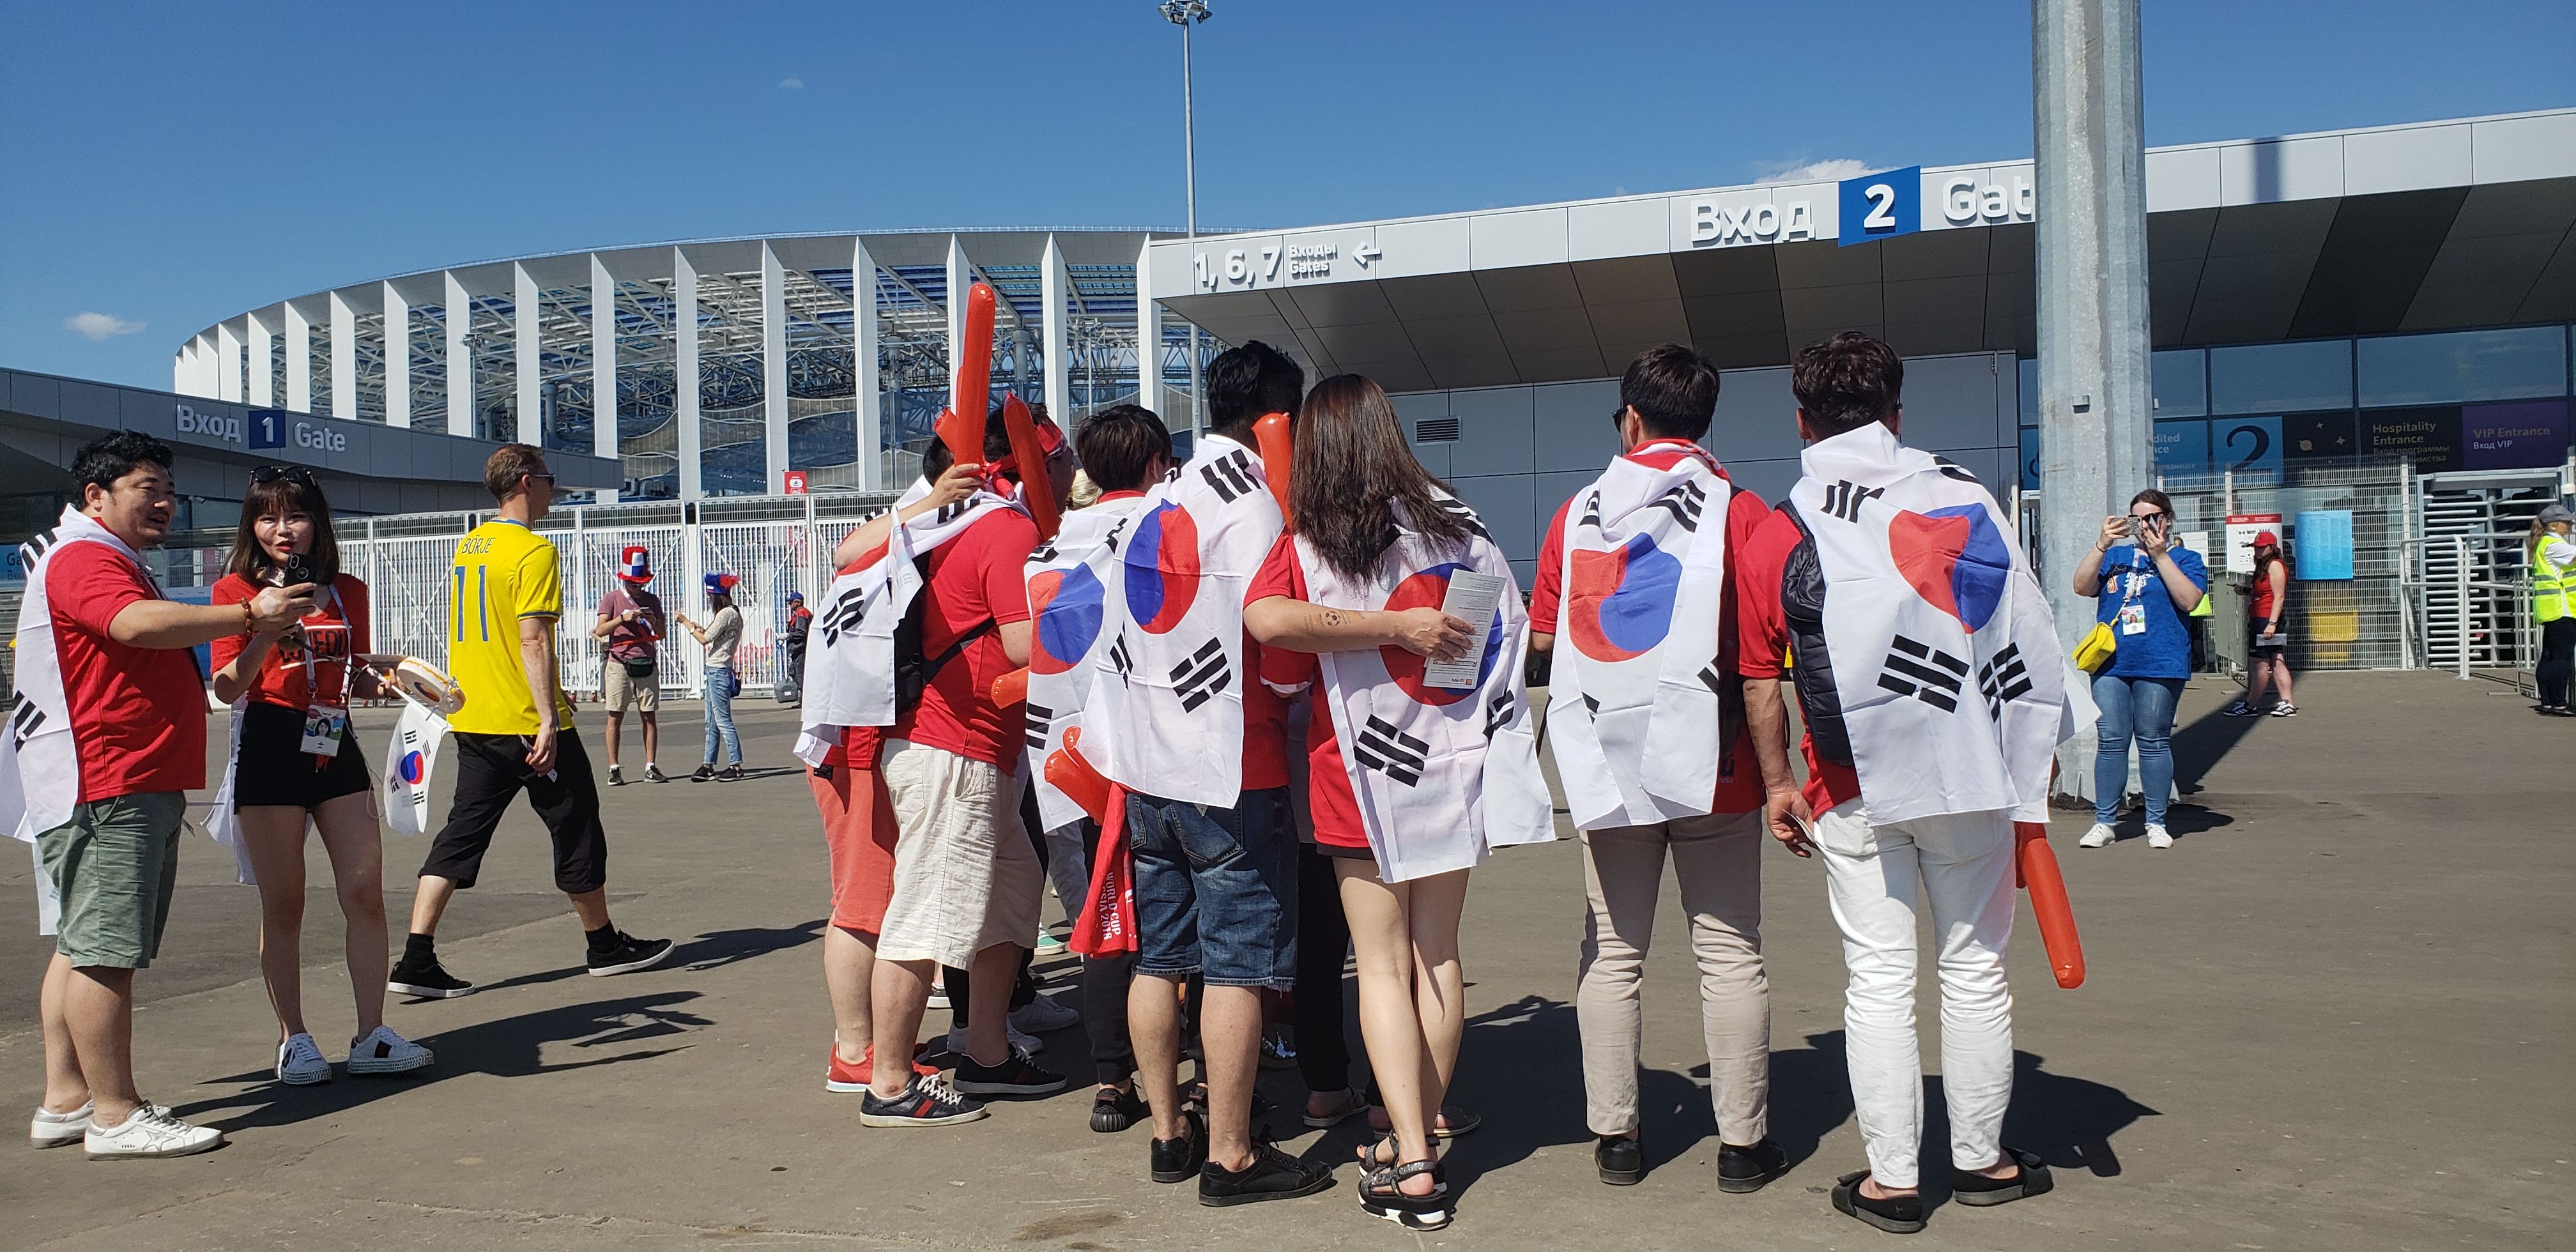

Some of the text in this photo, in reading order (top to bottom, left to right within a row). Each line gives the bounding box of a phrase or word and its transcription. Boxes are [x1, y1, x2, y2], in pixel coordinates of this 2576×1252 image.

[1690, 176, 2032, 241] Вход 2 Gat
[1288, 243, 1337, 258] Входы
[1194, 246, 1282, 287] 1, 6, 7
[1289, 260, 1329, 275] Gates
[177, 404, 346, 452] Вход 1 Gate
[2372, 421, 2436, 434] Hospitality
[2473, 428, 2550, 438] VIP Entrance
[2154, 433, 2180, 443] dited
[2373, 436, 2425, 445] Entrance
[2473, 441, 2495, 450] Вход
[2227, 425, 2271, 471] 2
[2397, 446, 2450, 455] программы
[461, 535, 495, 554] BÖRJE
[7, 553, 22, 566] Ga
[455, 565, 489, 642] 11
[1106, 872, 1121, 935] WORLD CUP
[1101, 913, 1112, 940] 2018
